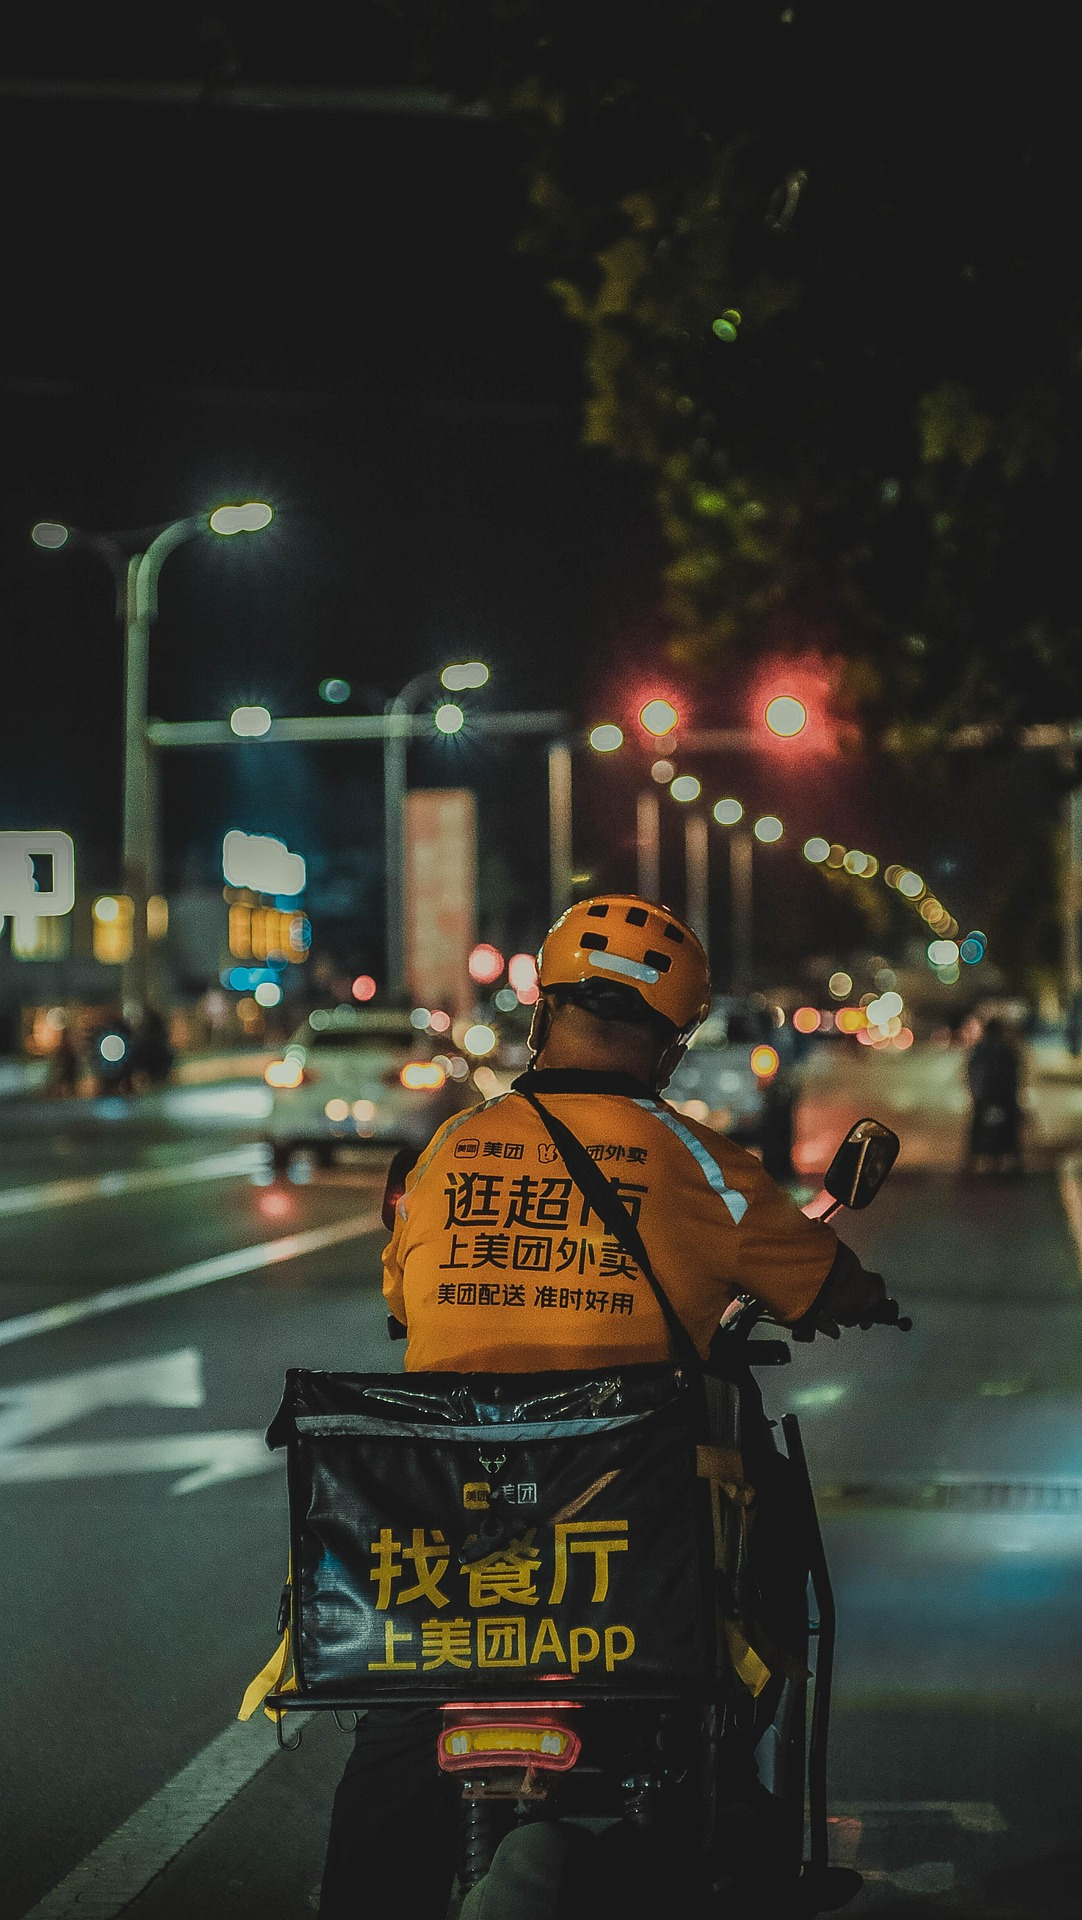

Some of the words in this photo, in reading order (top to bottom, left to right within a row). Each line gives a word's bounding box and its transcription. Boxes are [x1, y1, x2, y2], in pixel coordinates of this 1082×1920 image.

[482, 1141, 525, 1160] 美团
[562, 1144, 648, 1165] 团外卖
[438, 1232, 640, 1281] 上美团外卖
[437, 1282, 526, 1307] 美团配送
[533, 1285, 635, 1316] 准时好用
[369, 1519, 629, 1611] 找餐厅
[367, 1615, 636, 1674] 上美团App
